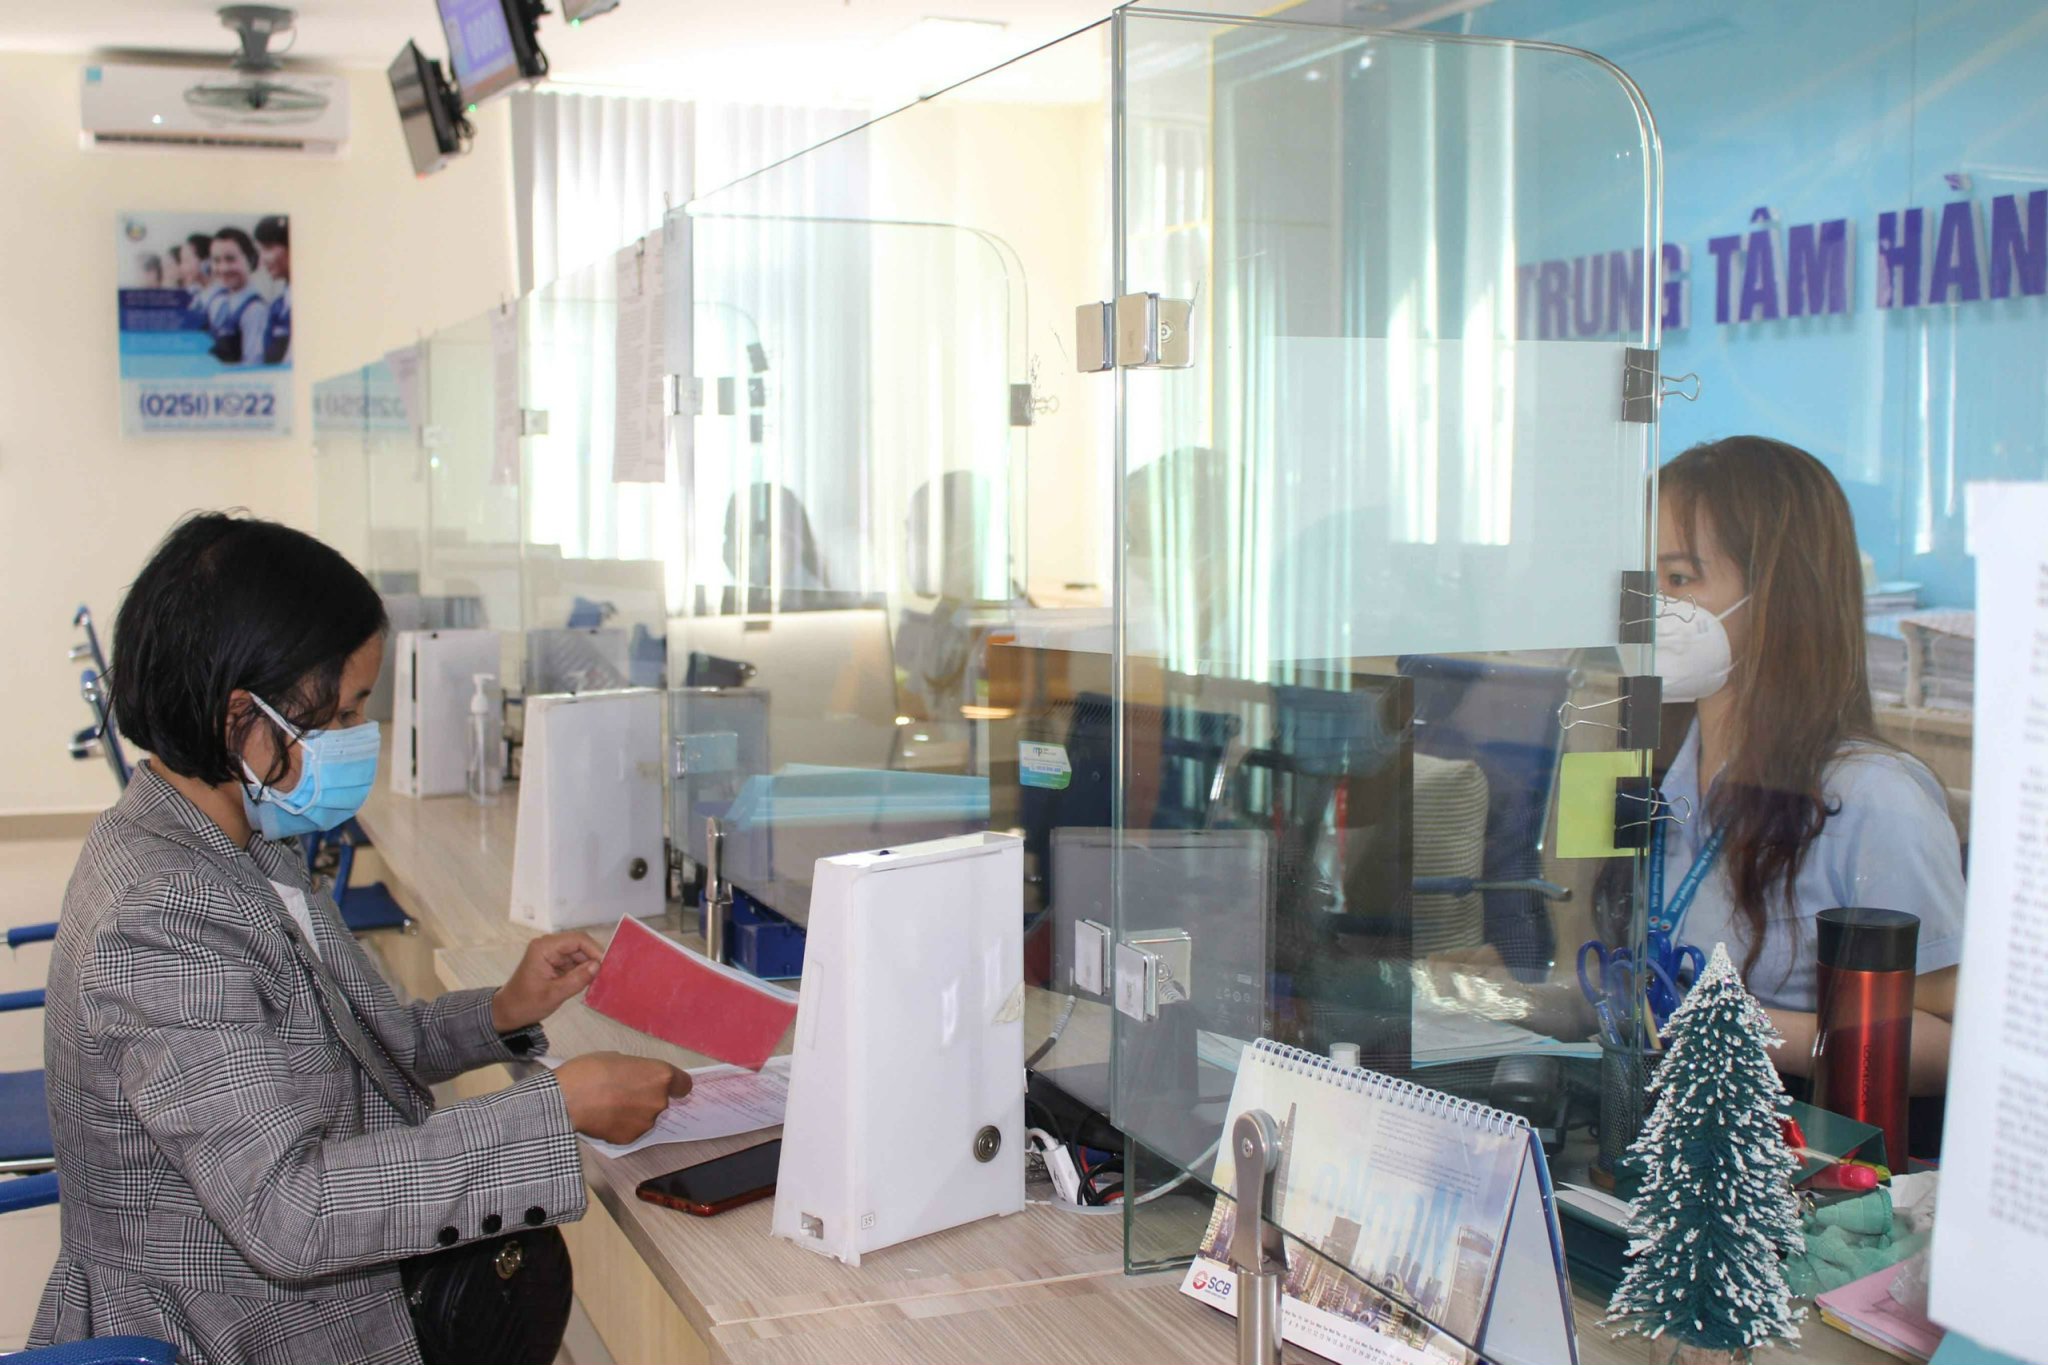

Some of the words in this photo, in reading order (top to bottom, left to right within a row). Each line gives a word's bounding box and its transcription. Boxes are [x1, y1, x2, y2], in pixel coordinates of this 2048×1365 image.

[1513, 241, 1688, 340] TRUNG
[1708, 206, 1850, 324] TÂM
[1875, 173, 2048, 309] HÀN
[1208, 1276, 1231, 1295] SCB
